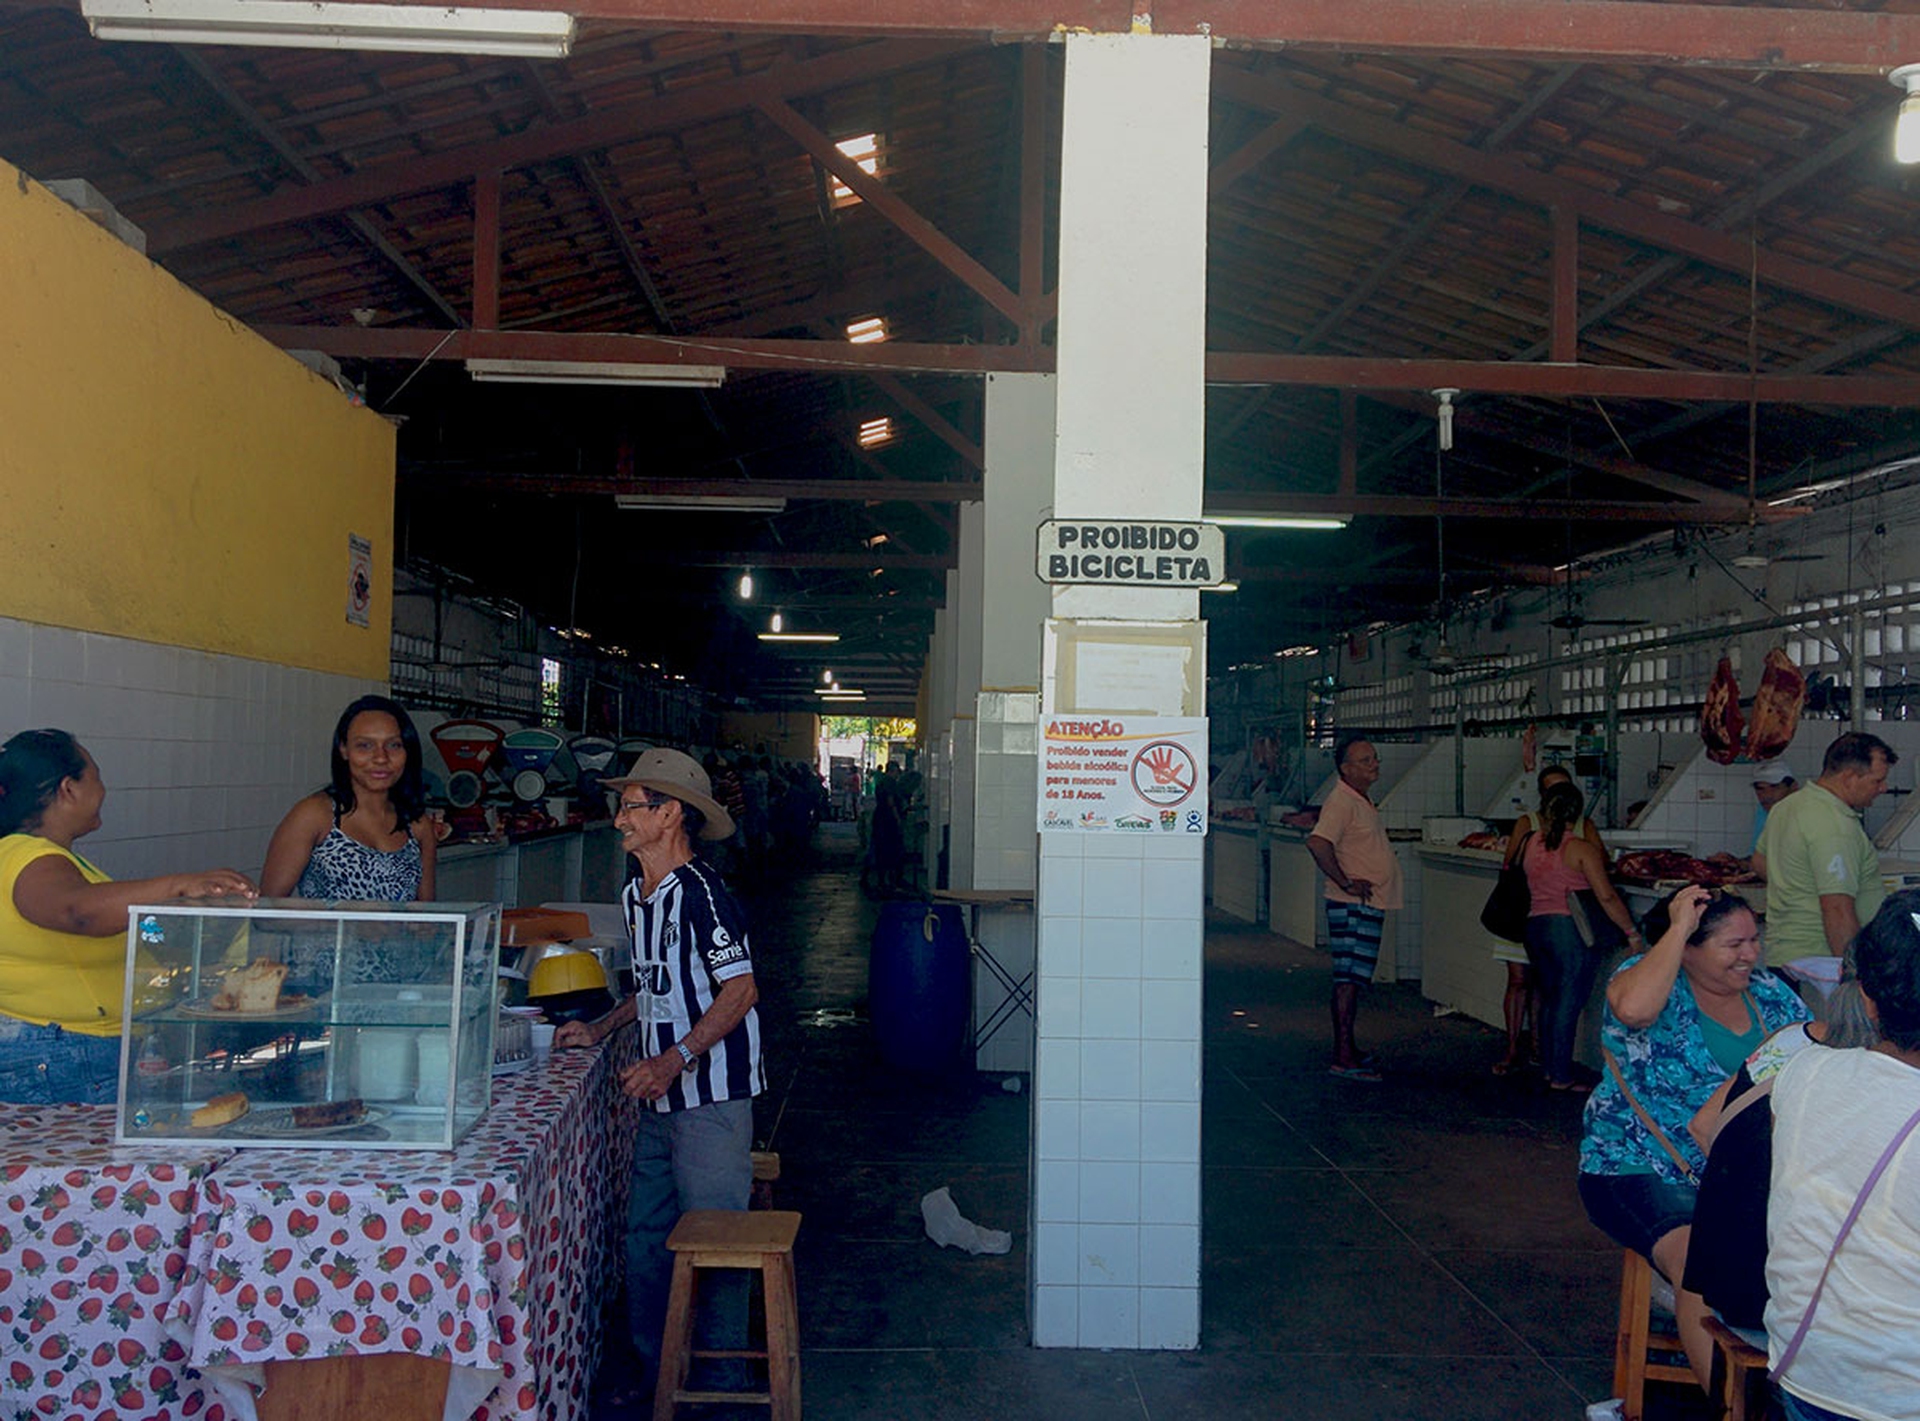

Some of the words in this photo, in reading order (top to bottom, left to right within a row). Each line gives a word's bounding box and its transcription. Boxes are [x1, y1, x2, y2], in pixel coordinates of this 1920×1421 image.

[1058, 525, 1199, 551] PROIBIDO
[1049, 554, 1211, 581] BICICLETA
[1047, 719, 1124, 740] ATENÇÃO
[1046, 746, 1090, 756] Proibido
[1092, 747, 1128, 757] vender
[1046, 760, 1081, 770] bebida
[1084, 761, 1128, 771] alcoólica
[1046, 776, 1069, 786] para
[1072, 777, 1117, 786] menores
[1046, 789, 1059, 799] de
[1062, 789, 1074, 799] 18
[1076, 790, 1106, 800] Anos.
